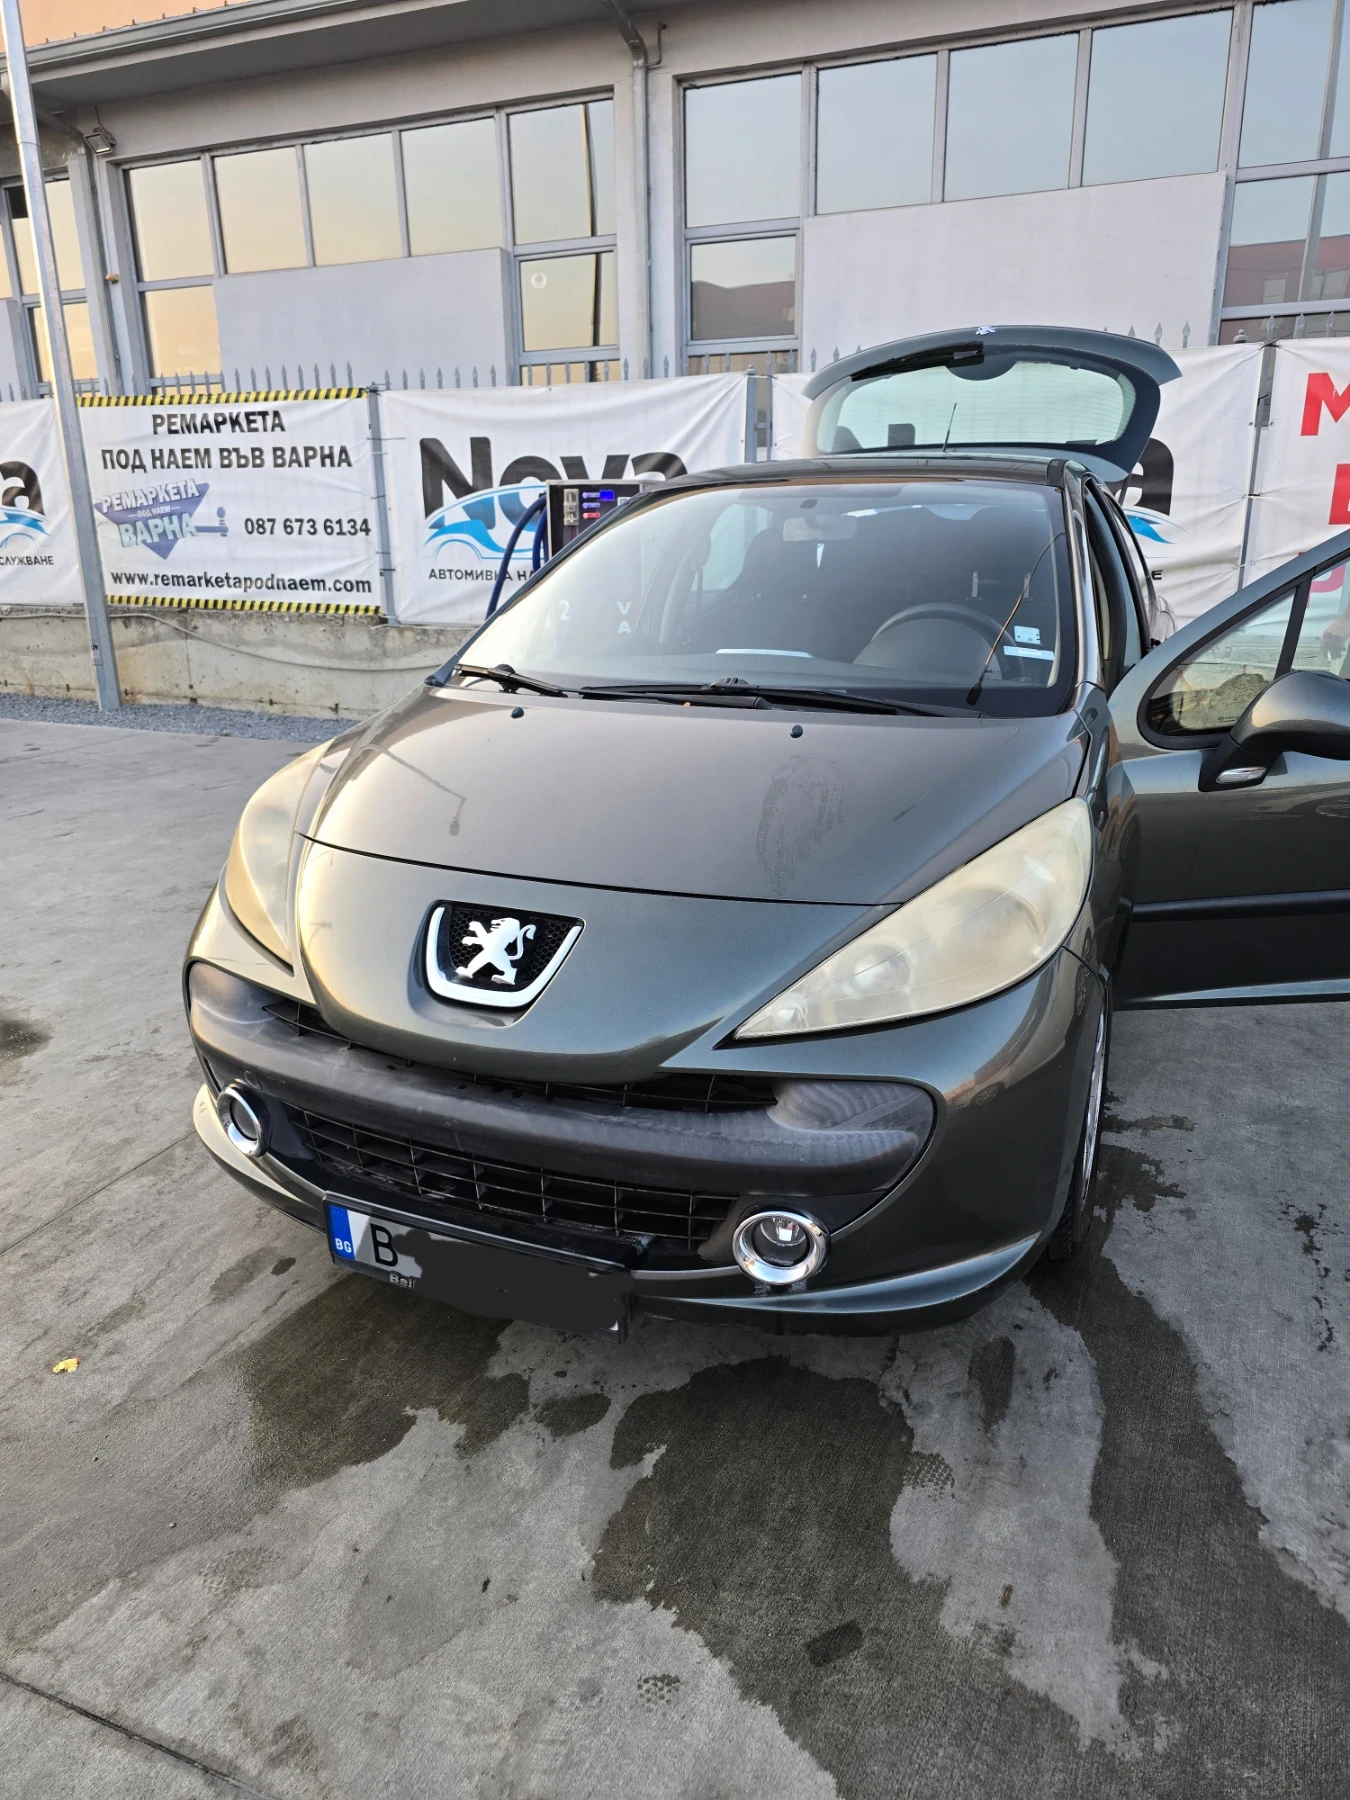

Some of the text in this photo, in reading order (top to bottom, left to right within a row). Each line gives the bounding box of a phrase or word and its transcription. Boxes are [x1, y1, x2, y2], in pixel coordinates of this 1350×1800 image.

[152, 410, 286, 435] РЕМАРКЕТА
[101, 445, 353, 474] ПОД НАЕМ ВЪВ ВАРНА
[101, 479, 200, 514] РЕМАРКЕТА
[137, 505, 171, 518] ПОД НАЕМ
[118, 512, 198, 548] ВАРНА
[244, 518, 371, 536] 087 673 6134
[111, 571, 372, 593] www.remarketapodnaem.com
[335, 1237, 353, 1254] BG
